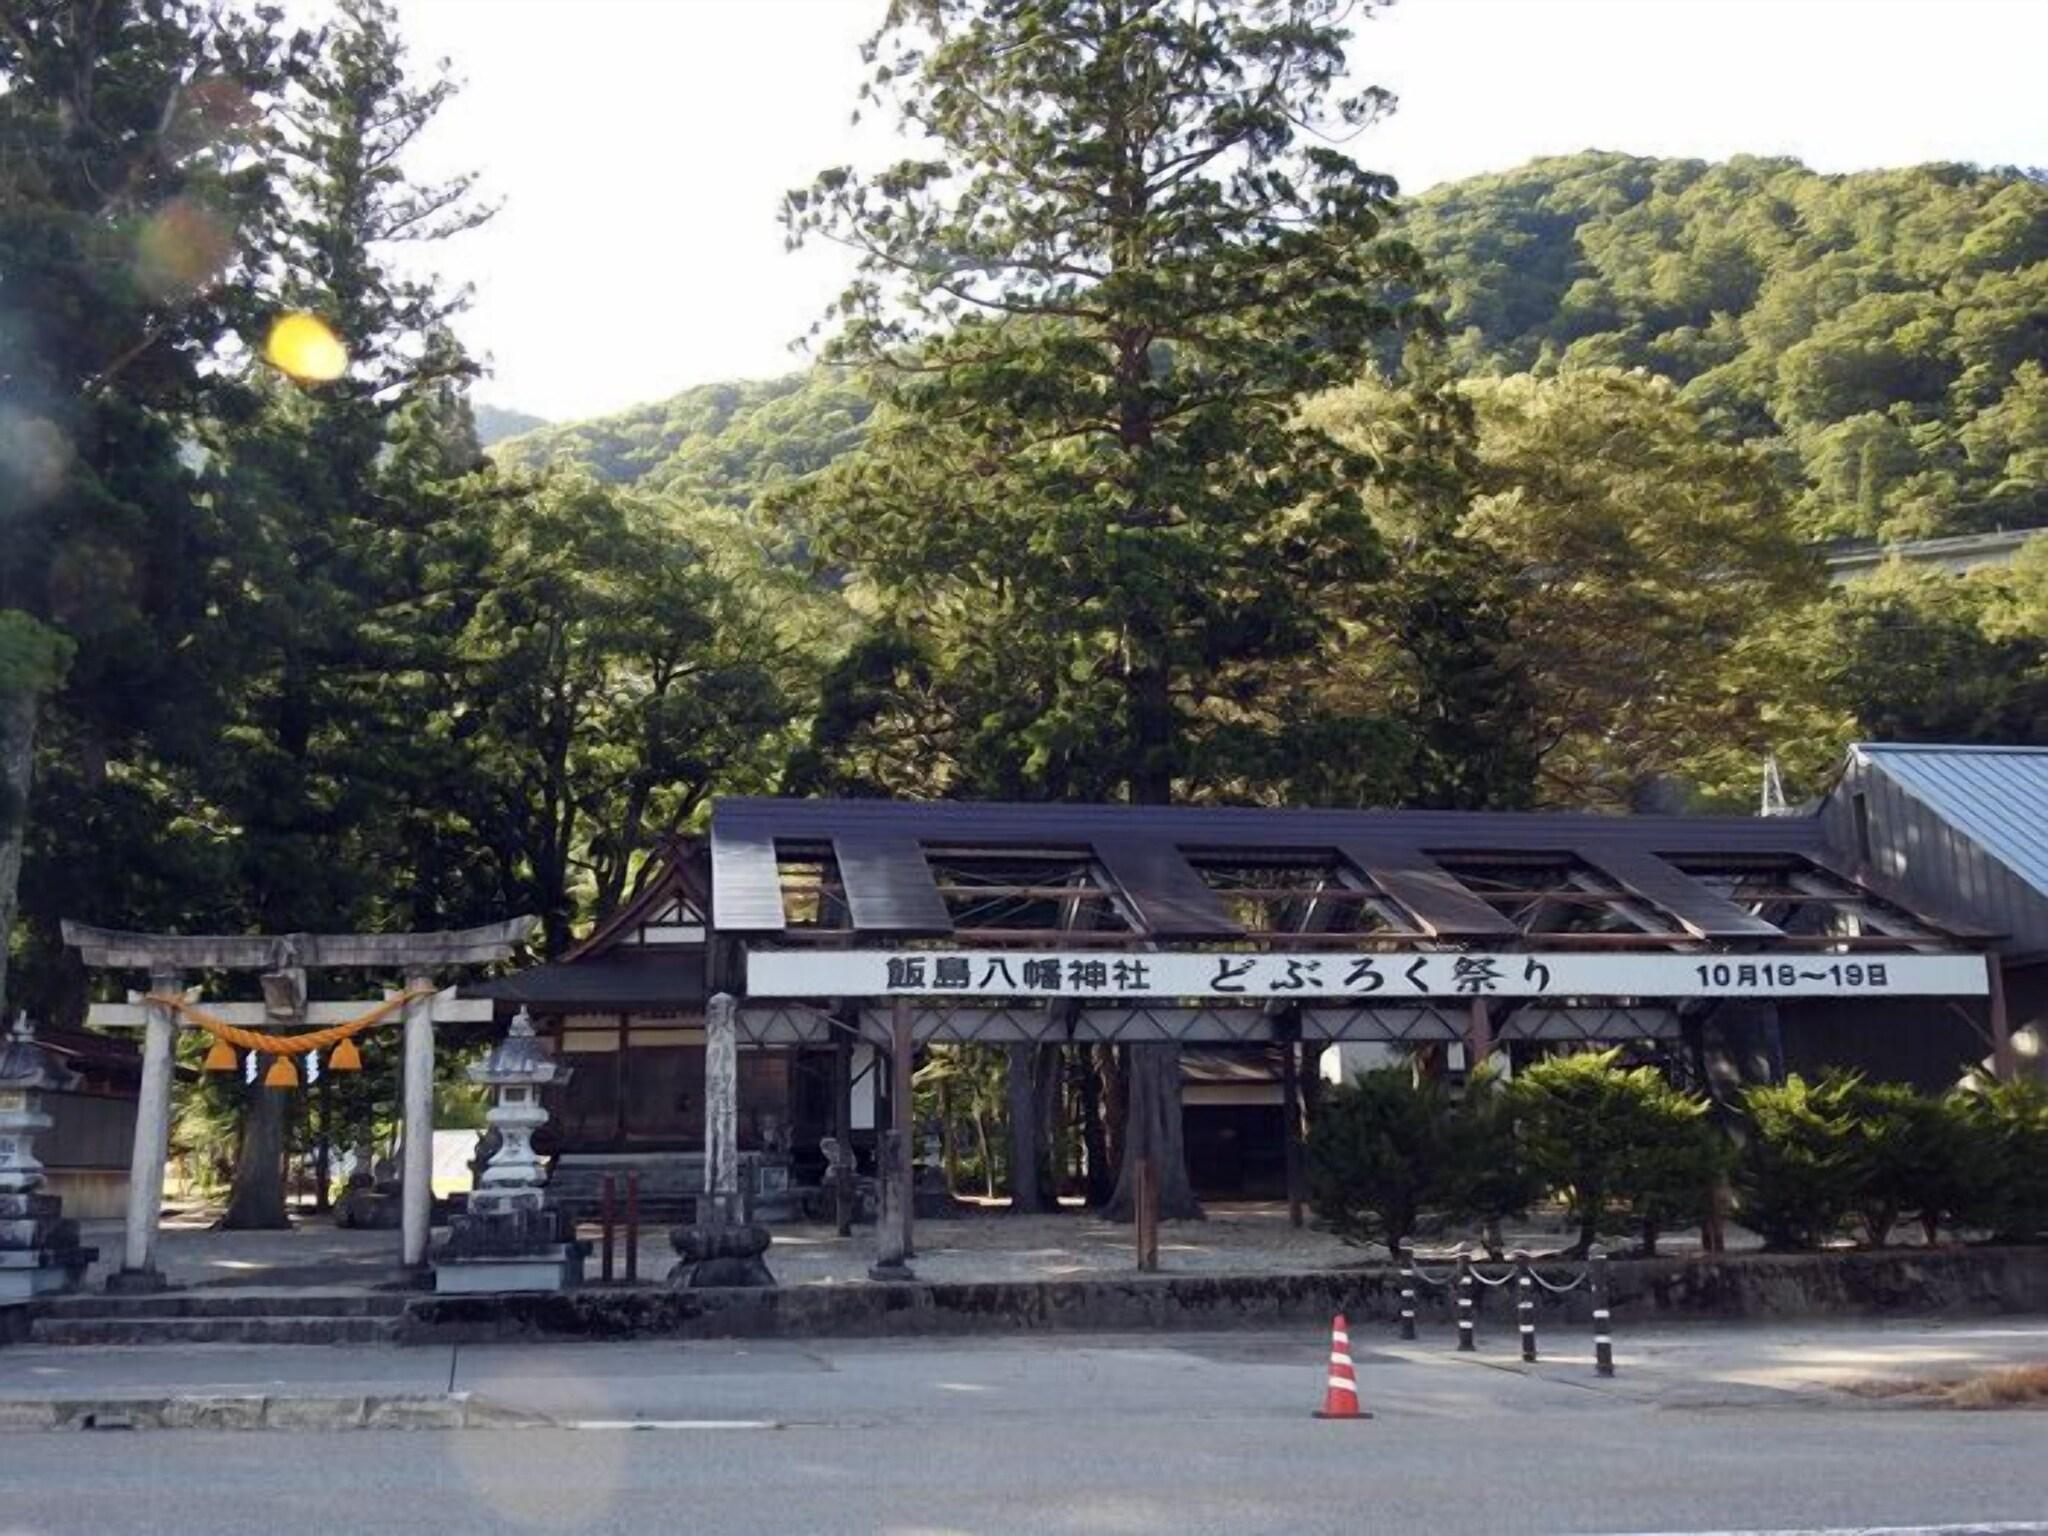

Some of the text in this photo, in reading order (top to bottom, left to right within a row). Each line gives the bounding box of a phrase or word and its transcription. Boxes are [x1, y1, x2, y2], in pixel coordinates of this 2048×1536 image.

[886, 956, 1151, 991] 飯島八幡神社
[1209, 957, 1551, 993] どぶろく祭り
